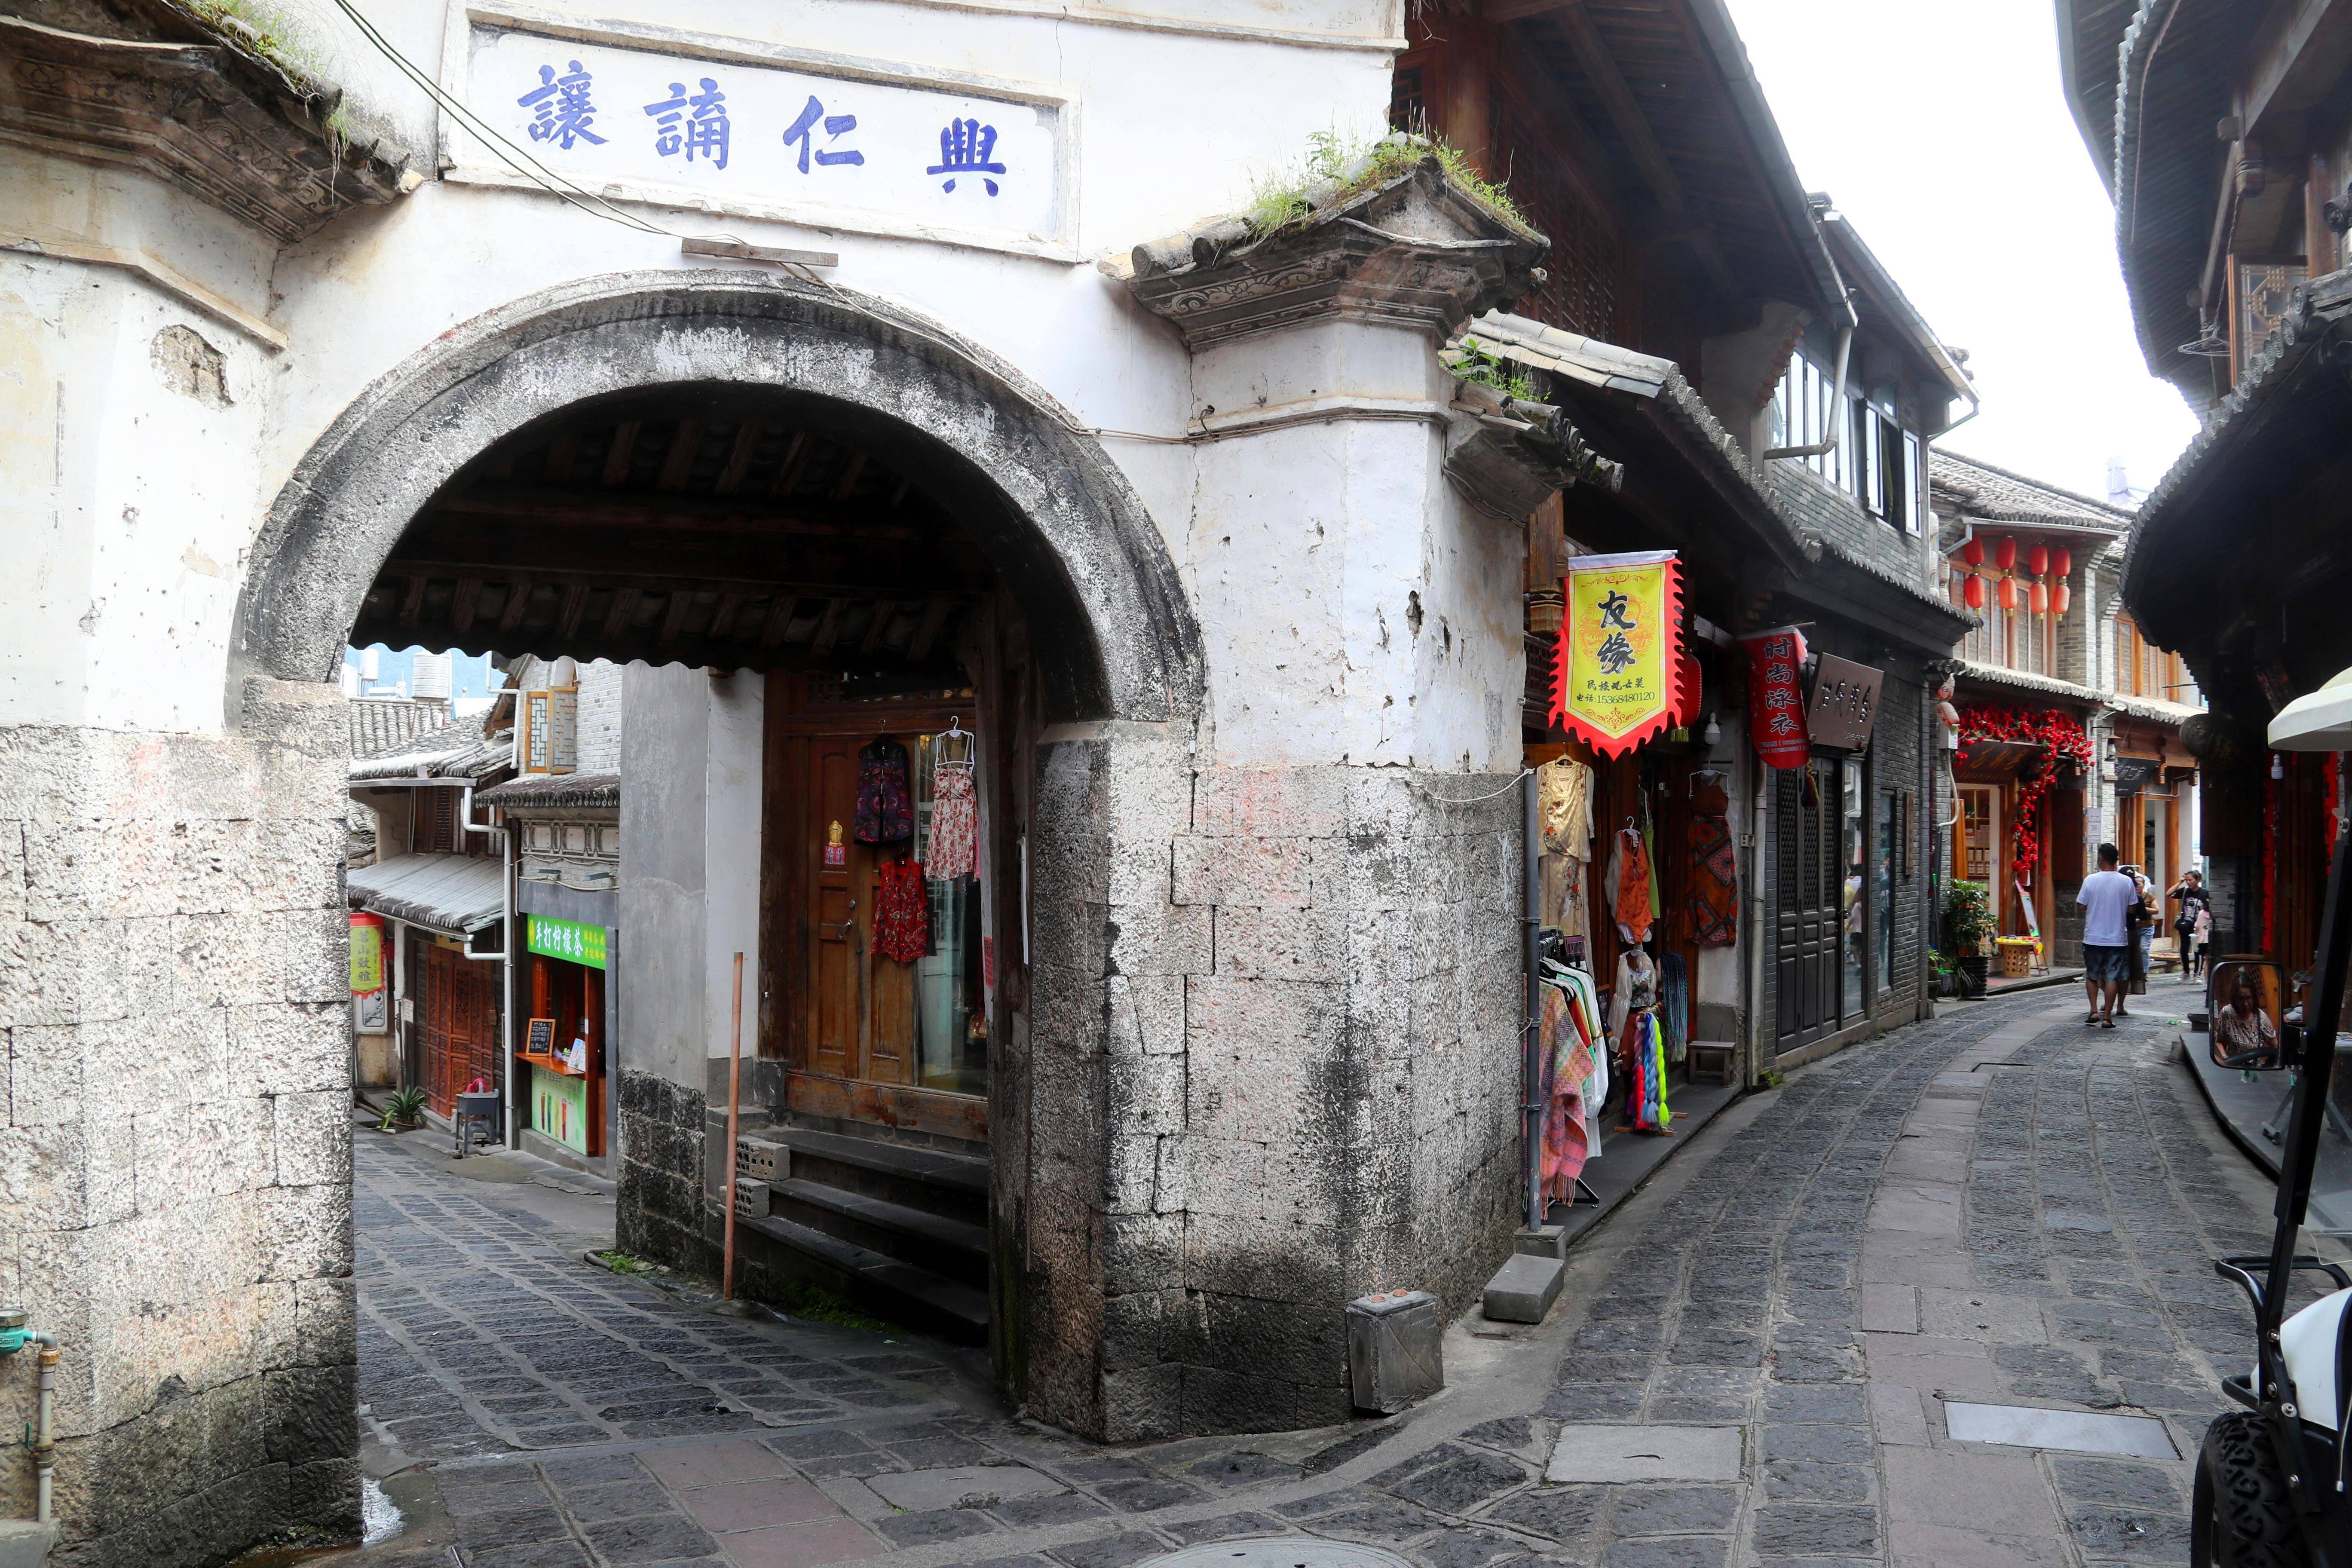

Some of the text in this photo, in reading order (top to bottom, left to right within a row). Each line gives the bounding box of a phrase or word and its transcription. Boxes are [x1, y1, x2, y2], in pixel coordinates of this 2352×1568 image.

[1597, 590, 1637, 675] 友缘
[1576, 691, 1655, 704] 电话:15368480120
[1764, 637, 1800, 736] 时尚泳衣
[536, 920, 583, 958] 手打柠檬茶
